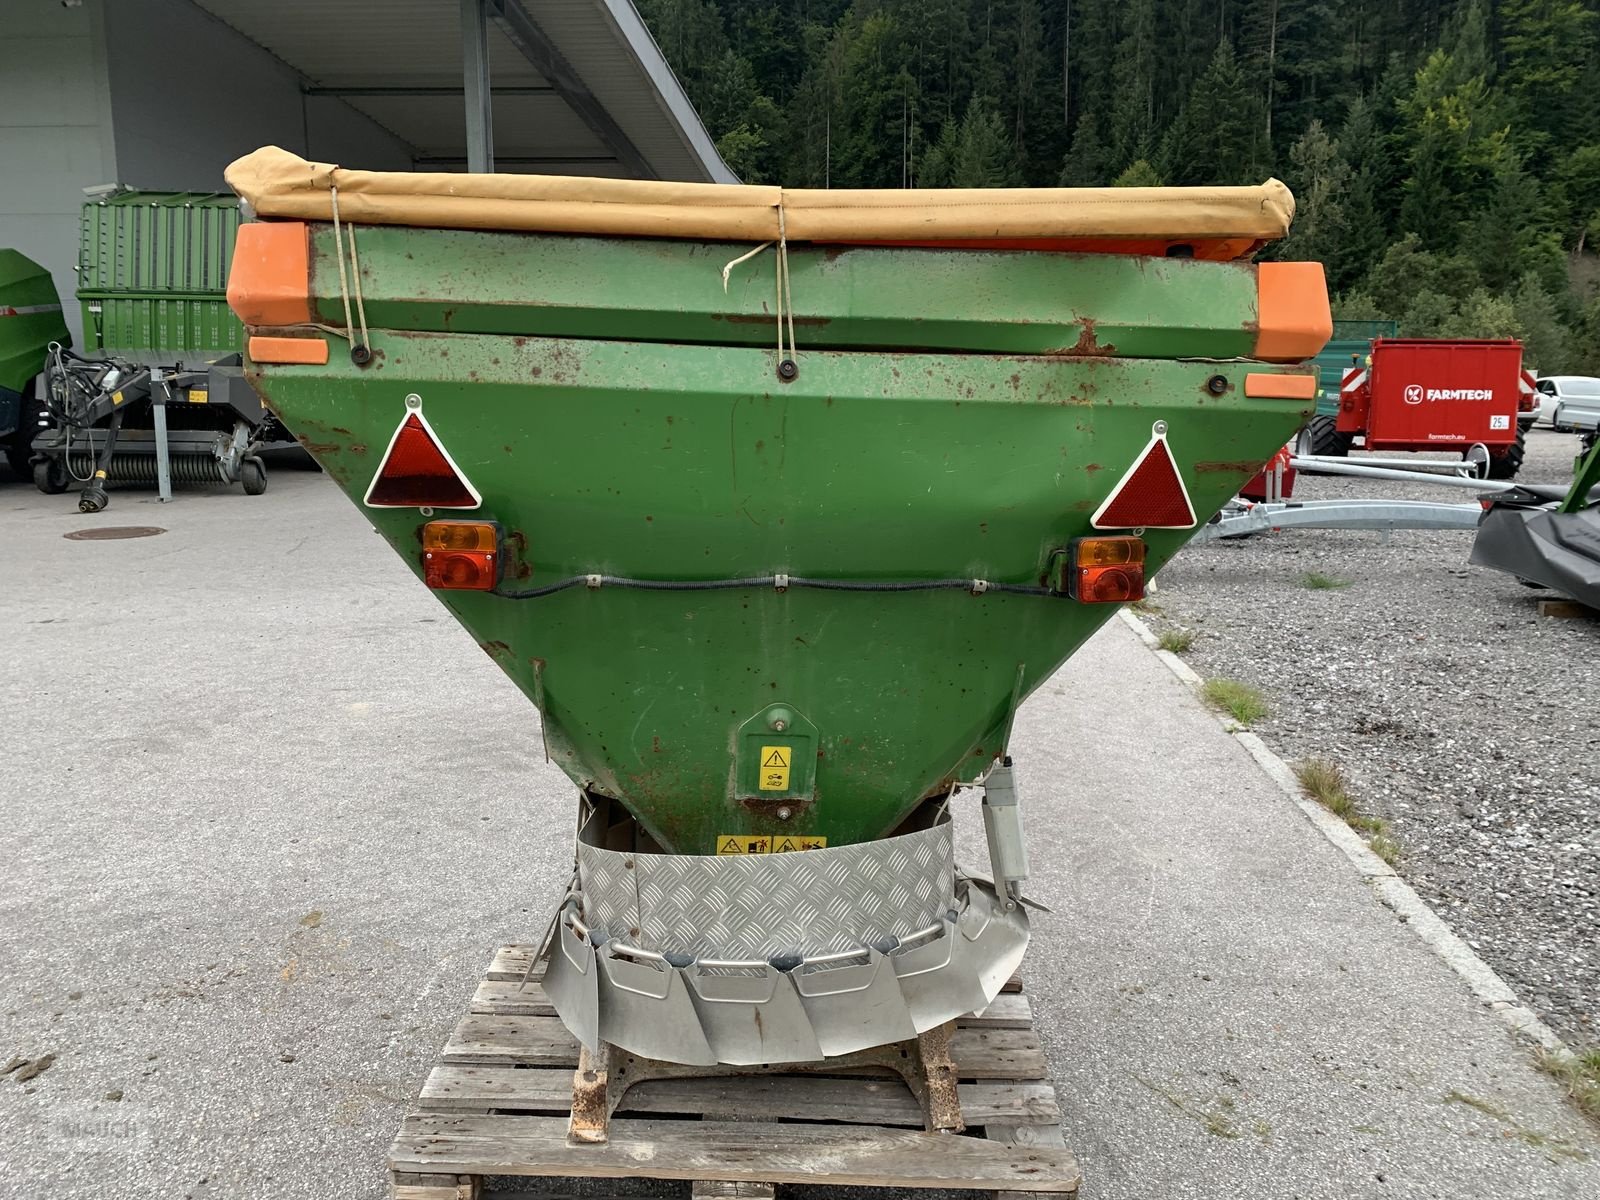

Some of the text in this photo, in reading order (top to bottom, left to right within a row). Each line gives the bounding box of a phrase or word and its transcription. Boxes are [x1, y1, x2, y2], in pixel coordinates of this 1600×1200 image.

[1427, 389, 1493, 401] FARMTECH
[1492, 416, 1503, 428] 25
[1428, 433, 1466, 441] farmtech.eu
